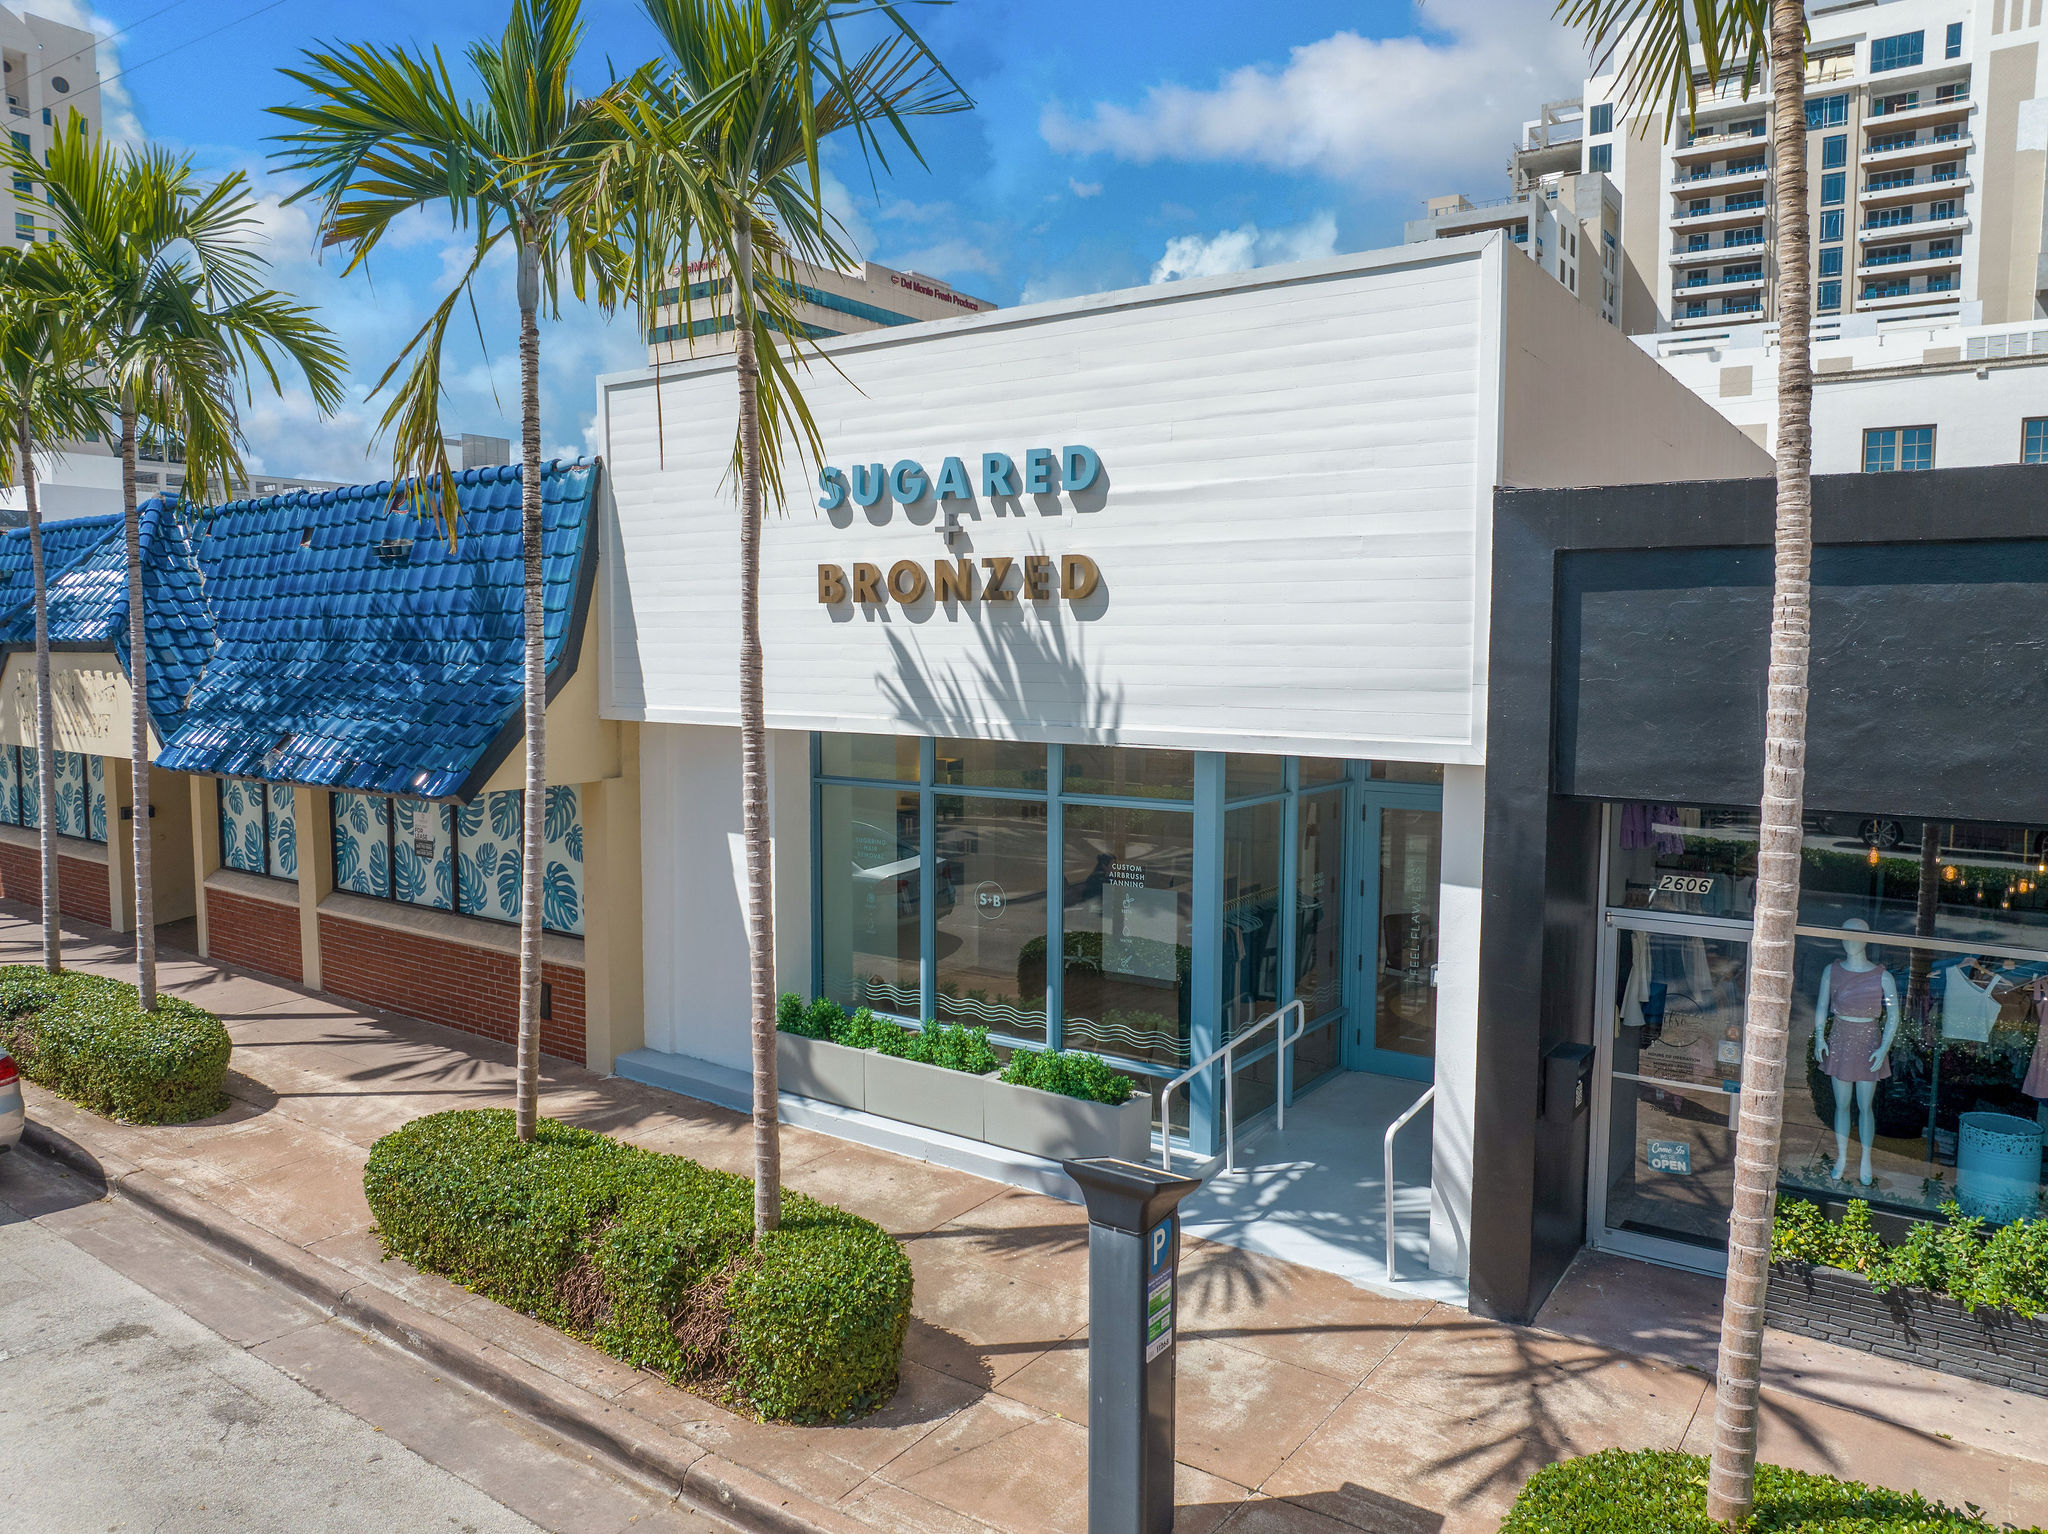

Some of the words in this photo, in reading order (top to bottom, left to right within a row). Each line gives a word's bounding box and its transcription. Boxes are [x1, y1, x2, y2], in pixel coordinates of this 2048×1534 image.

[901, 278, 912, 290] Del
[913, 281, 933, 297] Monte
[935, 288, 952, 304] Fresh
[953, 295, 978, 311] Produce
[818, 445, 1099, 510] SUGARED
[818, 554, 1099, 604] BRONZED
[1111, 863, 1142, 872] CUSTOM
[1109, 871, 1145, 881] AIRBRUSH
[1109, 878, 1144, 889] TANNING
[1661, 876, 1710, 892] 2606
[979, 892, 1001, 907] S+B
[1410, 944, 1419, 976] FEEL
[1651, 1142, 1673, 1154] Come
[1674, 1145, 1685, 1155] In
[1651, 1158, 1687, 1171] OPEN
[1153, 1228, 1165, 1266] P
